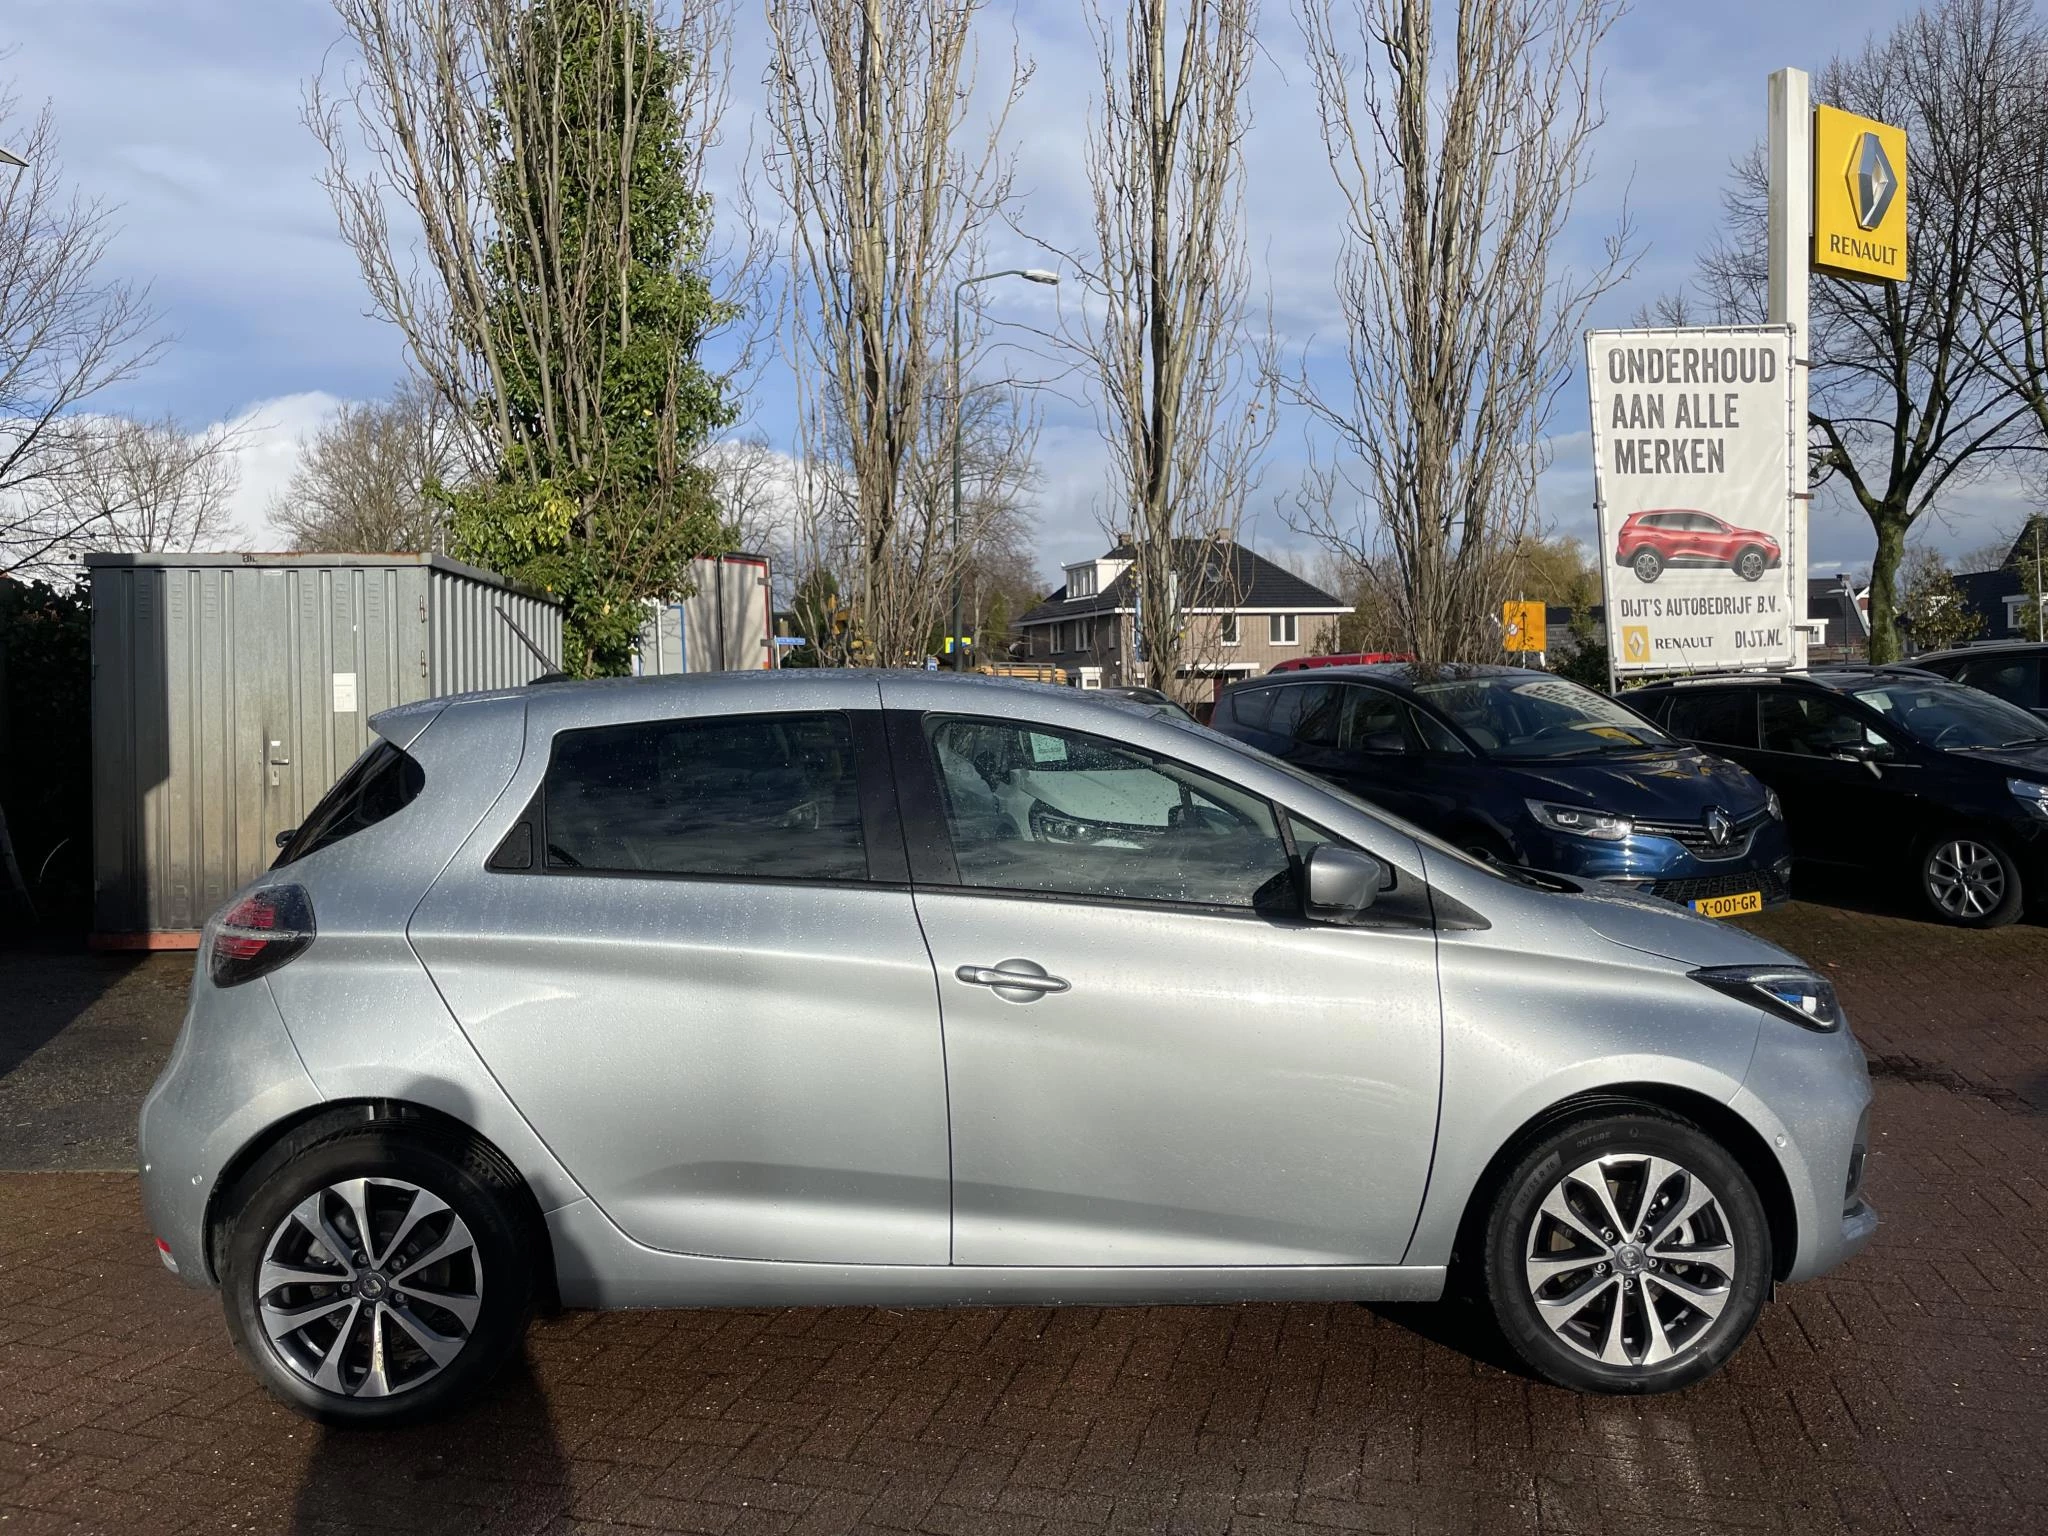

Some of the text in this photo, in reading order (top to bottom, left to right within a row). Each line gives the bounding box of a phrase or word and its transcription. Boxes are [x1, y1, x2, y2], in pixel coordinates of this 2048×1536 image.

[1830, 233, 1898, 266] RENAULT
[1608, 347, 1776, 384] ONDERHOUD
[1612, 393, 1740, 429] AAN ALLE
[1614, 438, 1725, 474] MERKEN
[1620, 594, 1782, 617] DIJT'S AUTOBEDRIJF B.V.
[1655, 636, 1714, 650] RENAULT
[1734, 628, 1783, 648] DIJT.NL
[1701, 895, 1757, 915] X-001-GR
